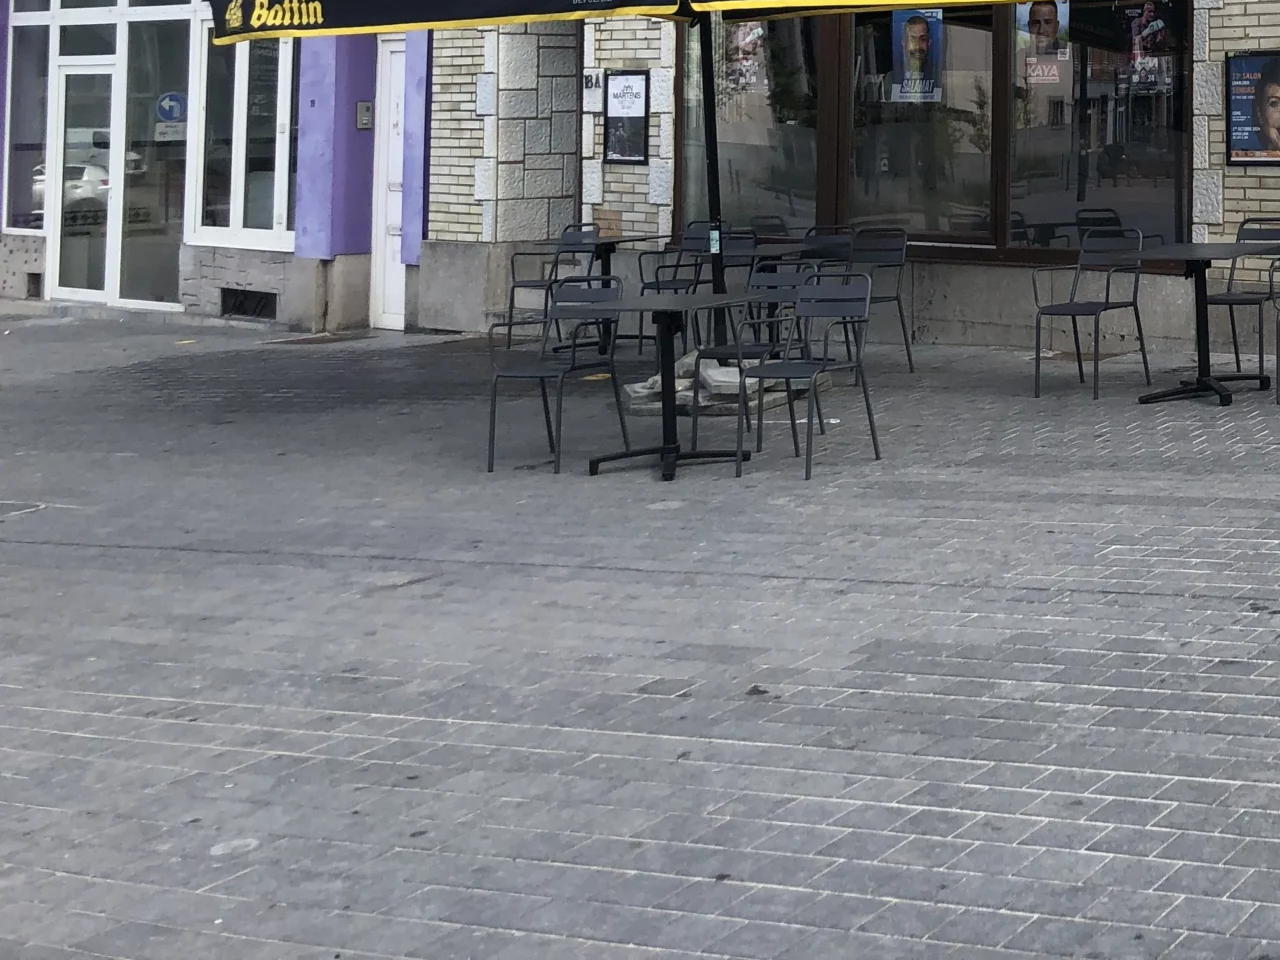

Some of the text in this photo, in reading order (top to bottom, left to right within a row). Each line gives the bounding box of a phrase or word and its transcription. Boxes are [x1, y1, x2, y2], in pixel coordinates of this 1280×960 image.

[1027, 64, 1058, 76] KAYA
[902, 80, 934, 92] SALAMAT
[612, 92, 641, 100] MARTENS
